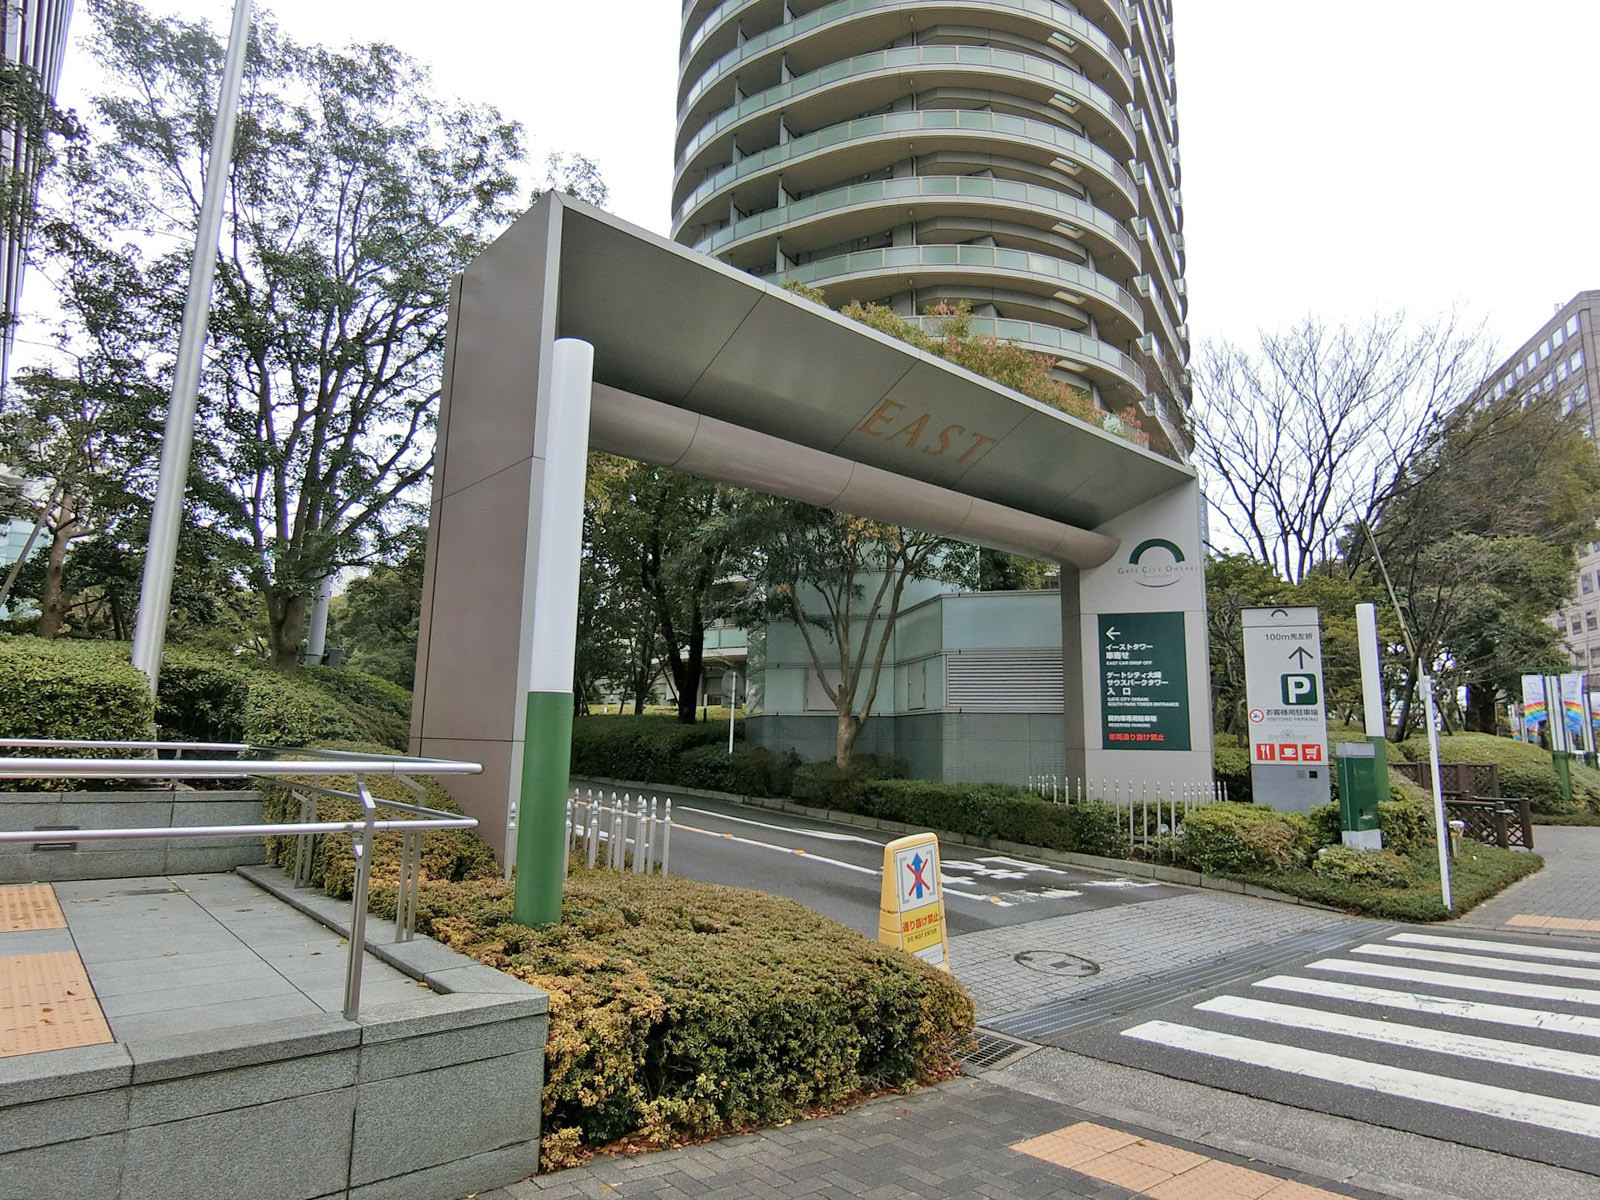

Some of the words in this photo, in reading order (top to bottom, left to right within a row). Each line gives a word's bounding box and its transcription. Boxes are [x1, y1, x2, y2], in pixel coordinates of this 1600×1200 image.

[858, 399, 998, 464] EAST
[1265, 632, 1313, 641] 100m先左折
[1105, 643, 1154, 651] イーストタワー
[1105, 651, 1130, 660] 車寄せ
[1106, 671, 1162, 679] ゲートシティ大崎
[1106, 679, 1169, 687] サウスパークタワー
[1287, 676, 1311, 704] P
[902, 913, 939, 933] 通り抜け禁止
[906, 935, 914, 943] DO
[914, 932, 924, 941] NOT
[924, 928, 938, 938] ENTER
